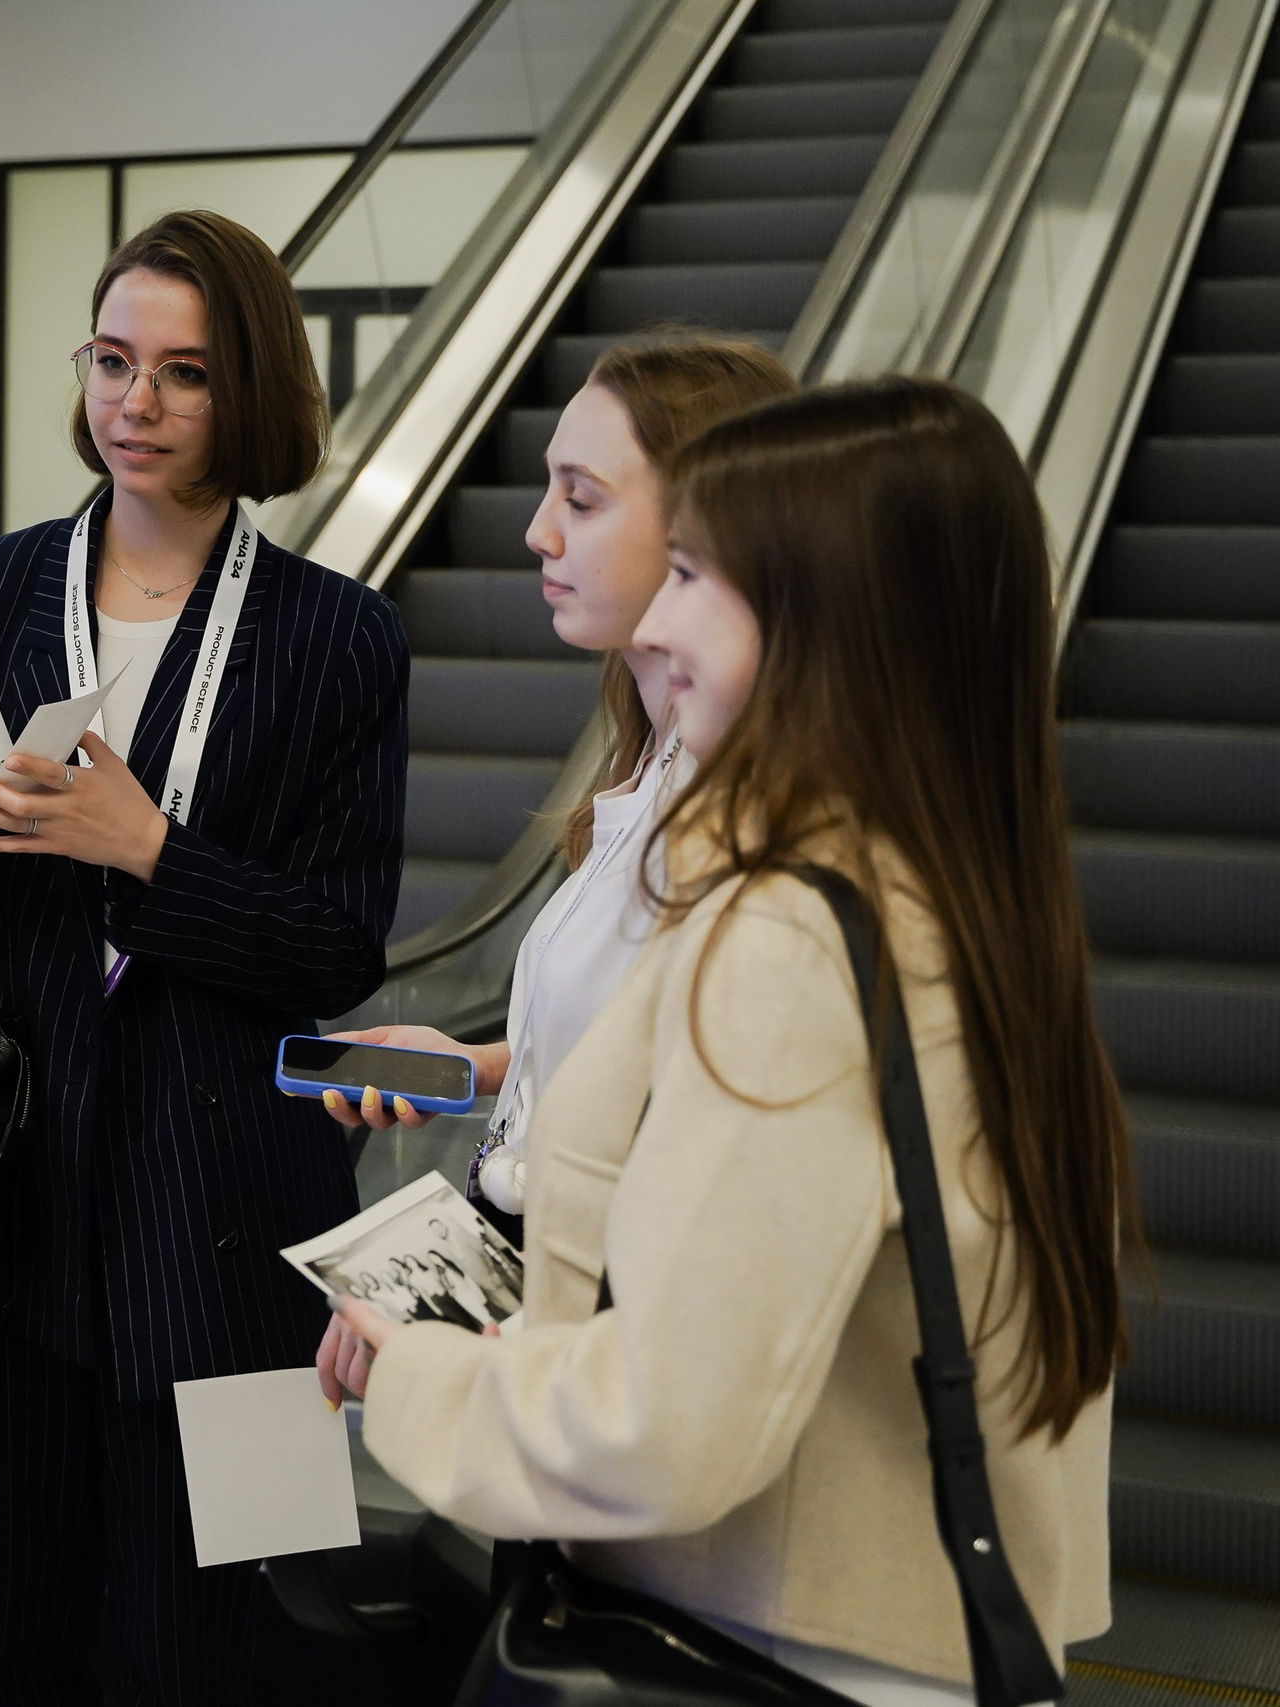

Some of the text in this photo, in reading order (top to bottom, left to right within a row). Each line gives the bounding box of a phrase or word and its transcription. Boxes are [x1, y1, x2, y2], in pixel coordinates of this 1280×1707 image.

[230, 529, 250, 579] AHA'24
[71, 583, 86, 688] PRODUCT SCIENCE
[189, 626, 225, 734] PRODUCT SCIENCE
